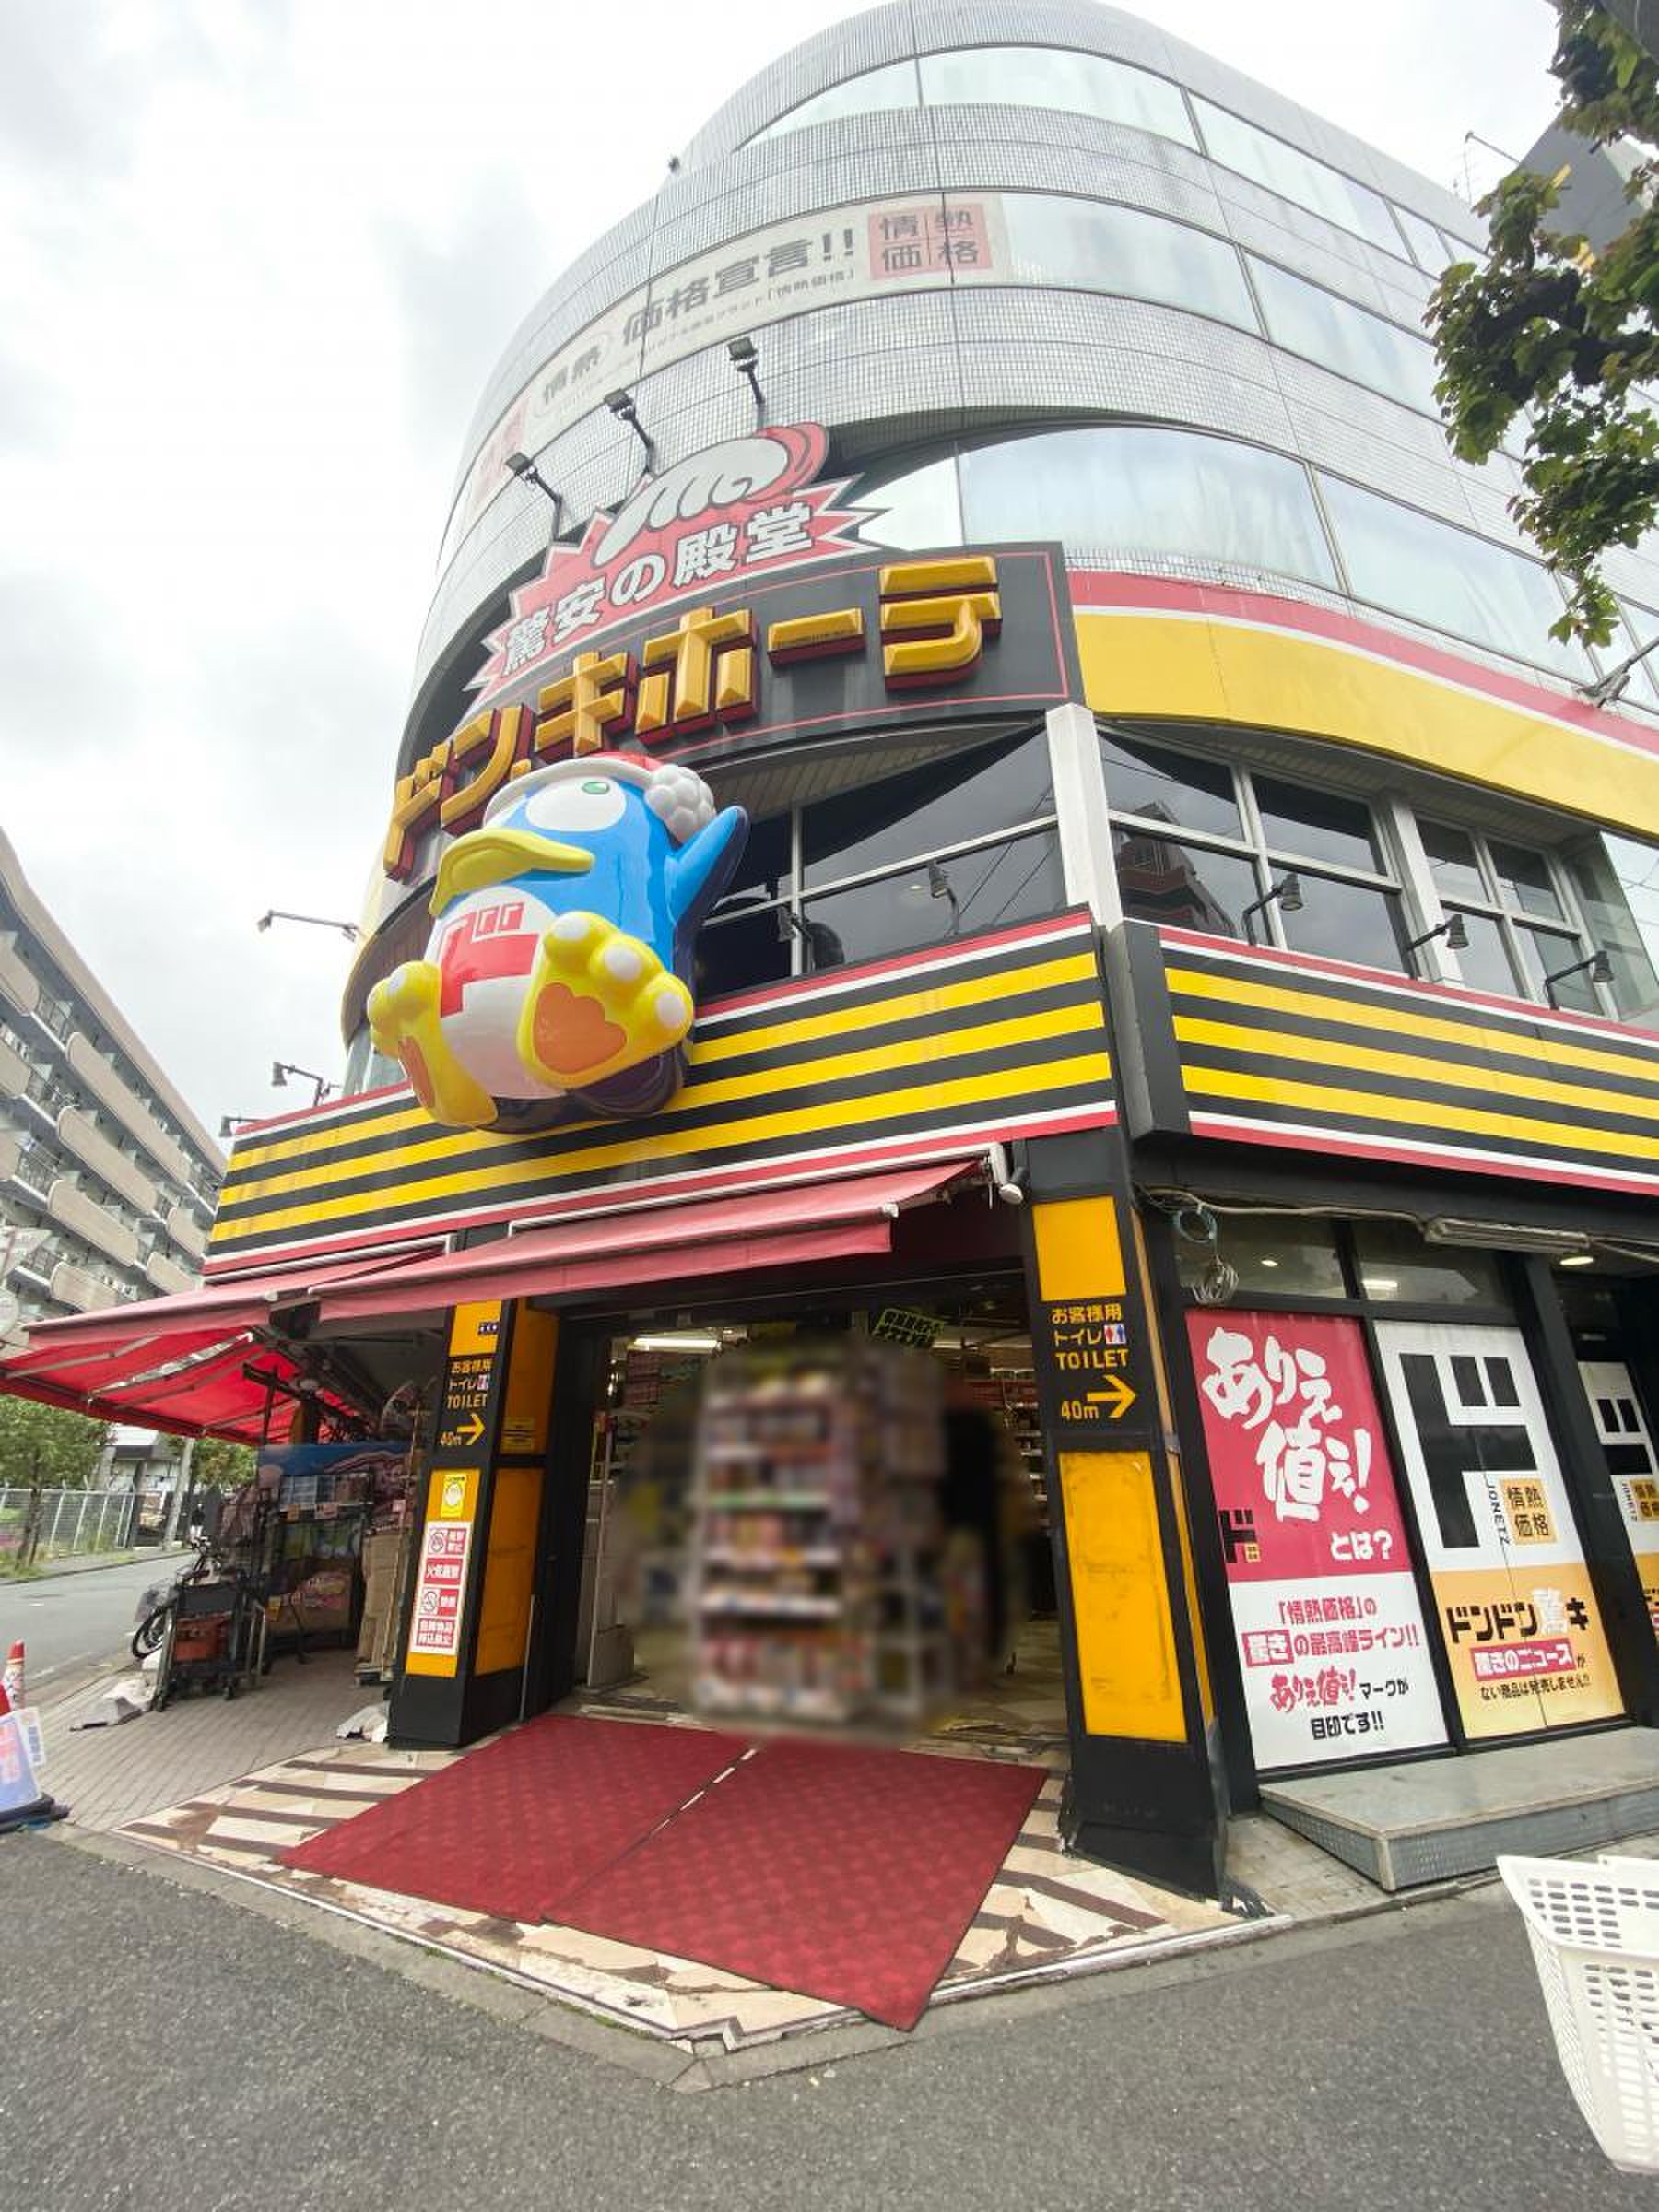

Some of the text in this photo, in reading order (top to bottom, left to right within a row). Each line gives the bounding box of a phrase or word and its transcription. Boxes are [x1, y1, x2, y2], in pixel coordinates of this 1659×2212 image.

[881, 240, 979, 272] 価格
[502, 500, 814, 677] 驚安の殿堂
[1052, 1303, 1122, 1324] お客様用
[1053, 1328, 1102, 1347] トイレ
[1054, 1348, 1129, 1371] TOILET
[448, 1377, 477, 1392] トイレ
[1201, 1326, 1343, 1430] ありえ
[446, 1393, 488, 1410] TOILET
[1061, 1400, 1100, 1420] 40m
[1399, 1353, 1538, 1548] ド
[1488, 1485, 1511, 1545] JONETZ
[1514, 1513, 1549, 1537] 価格
[1330, 1528, 1393, 1560] とは?
[1359, 1677, 1409, 1700] マークが
[1310, 1710, 1385, 1741] 目印です!!
